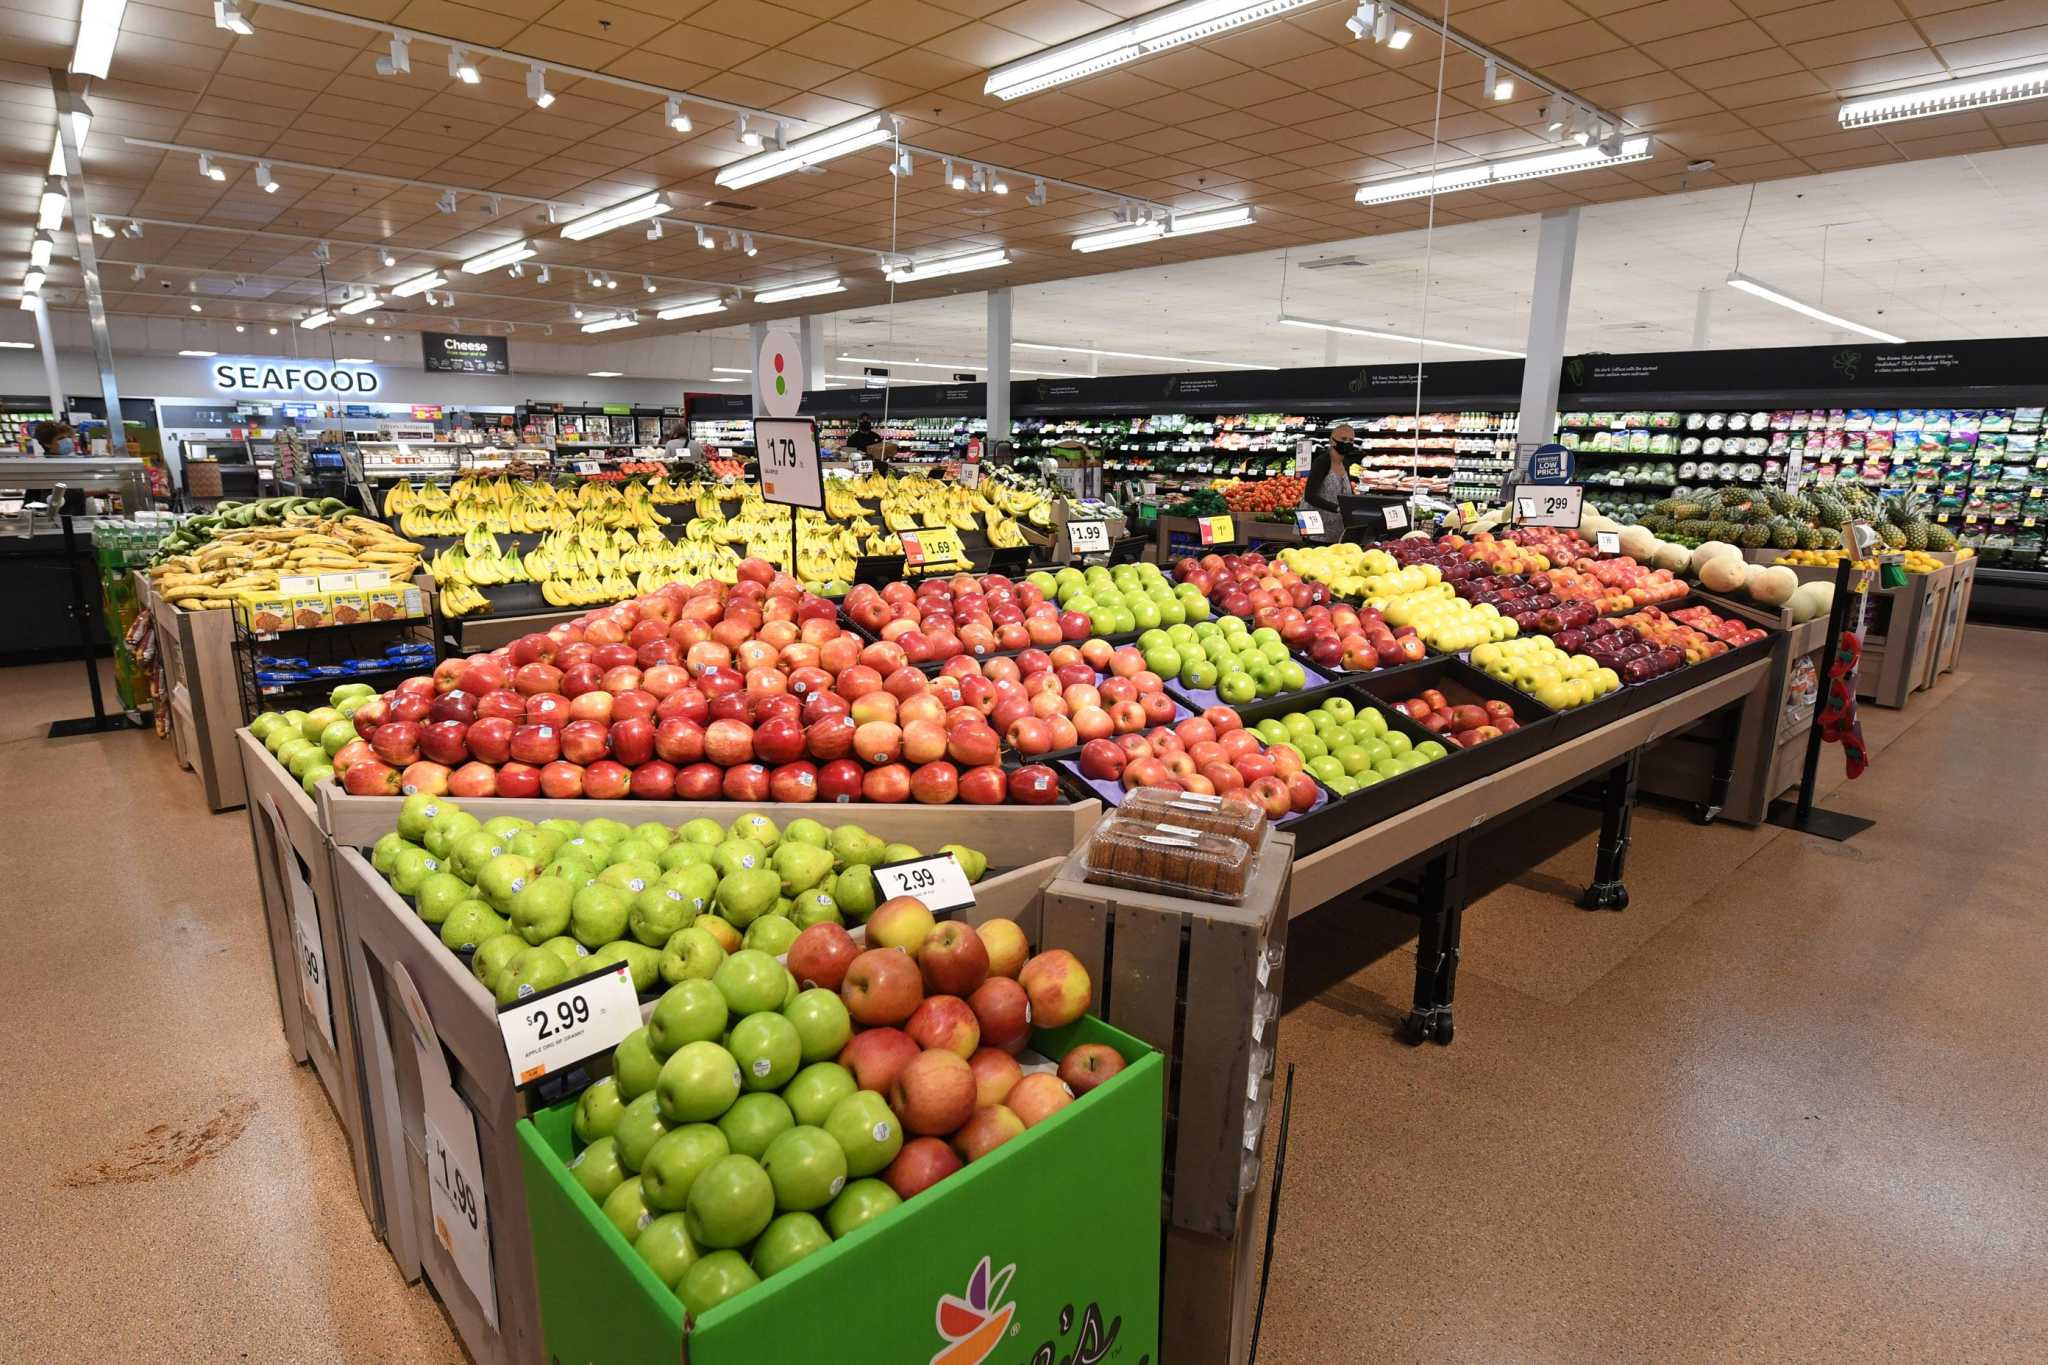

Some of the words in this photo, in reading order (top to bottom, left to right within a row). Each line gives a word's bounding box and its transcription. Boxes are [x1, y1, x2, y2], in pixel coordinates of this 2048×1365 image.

[444, 339, 488, 352] Cheese
[217, 365, 377, 392] SEAFOOD
[1536, 468, 1560, 476] PRICE
[1071, 526, 1100, 540] $1.99
[893, 868, 935, 892] $2.99
[526, 995, 590, 1040] $2.99
